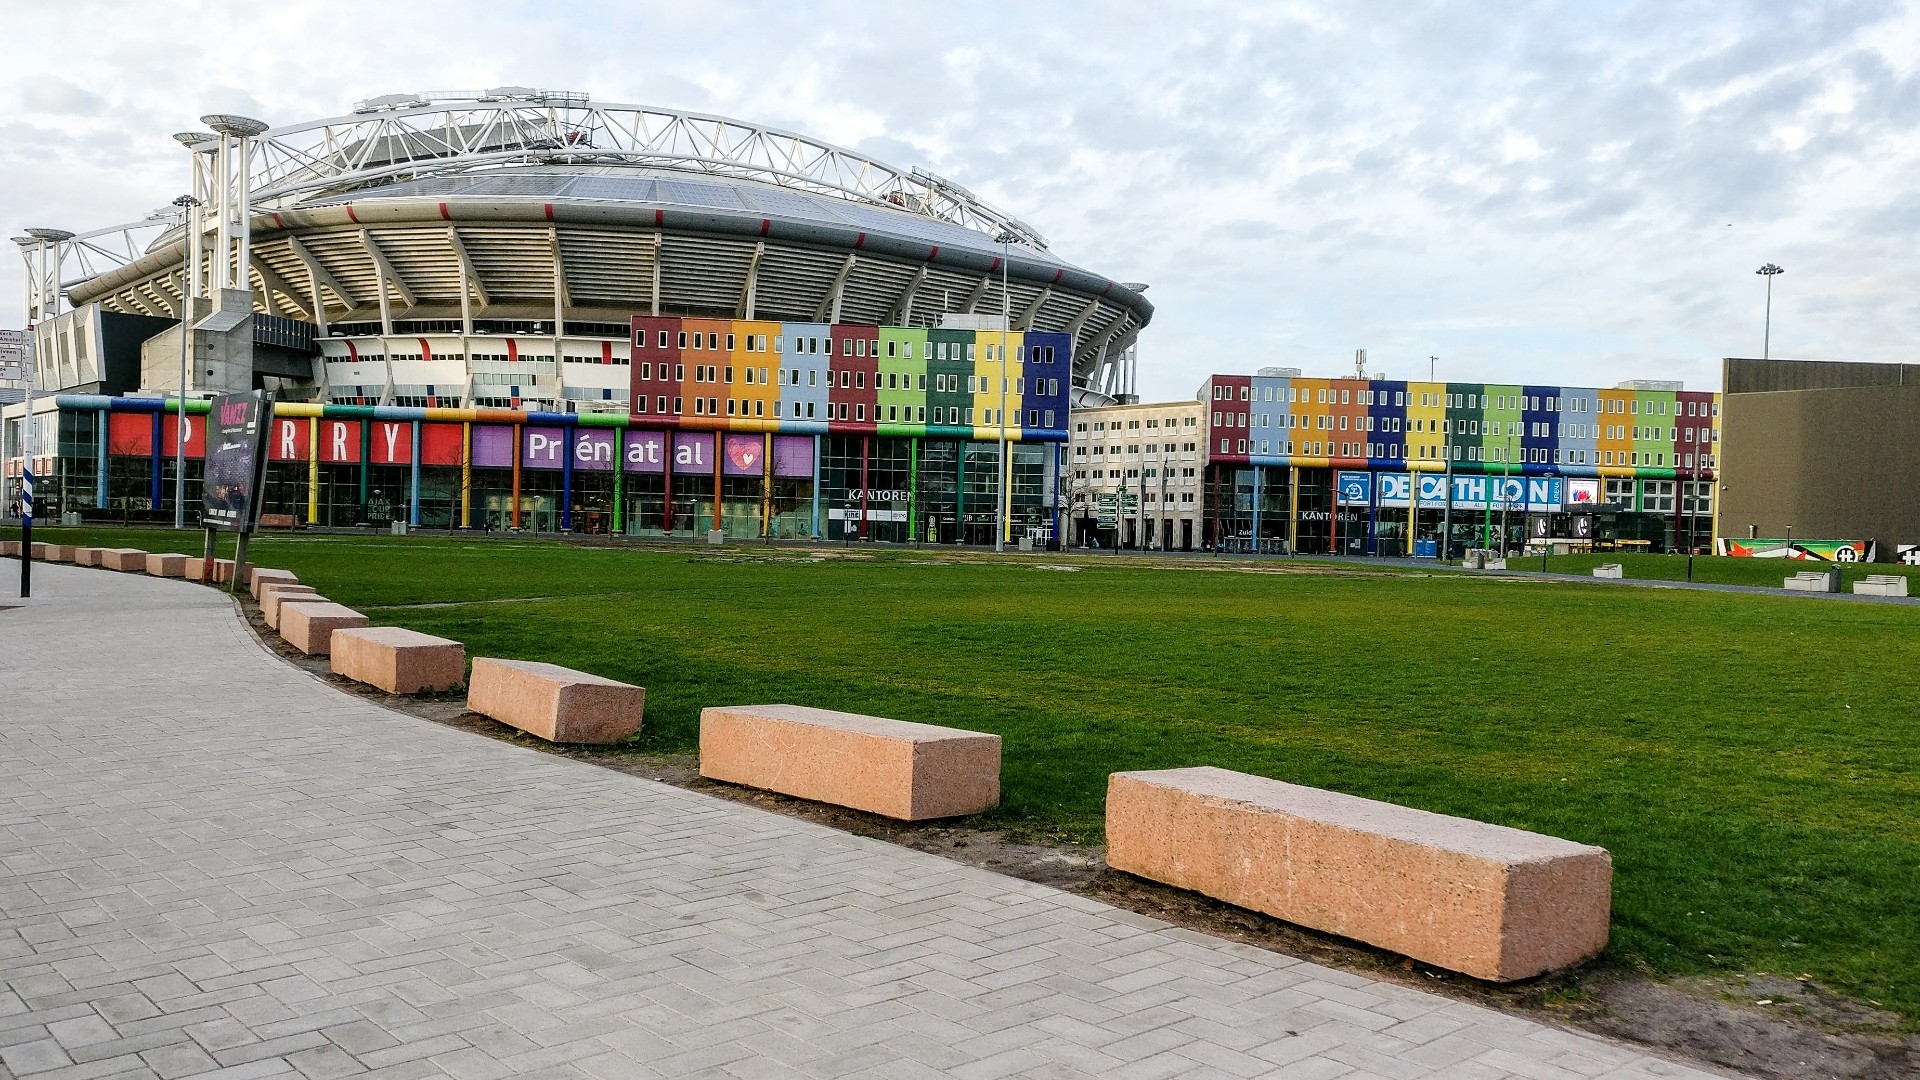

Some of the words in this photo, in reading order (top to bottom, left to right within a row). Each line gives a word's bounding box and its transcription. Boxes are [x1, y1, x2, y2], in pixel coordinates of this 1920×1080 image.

[529, 434, 703, 465] Prénatal
[849, 490, 914, 501] KANTOREN
[1380, 476, 1548, 502] DECATHLON
[1302, 511, 1358, 521] KANTOREN
